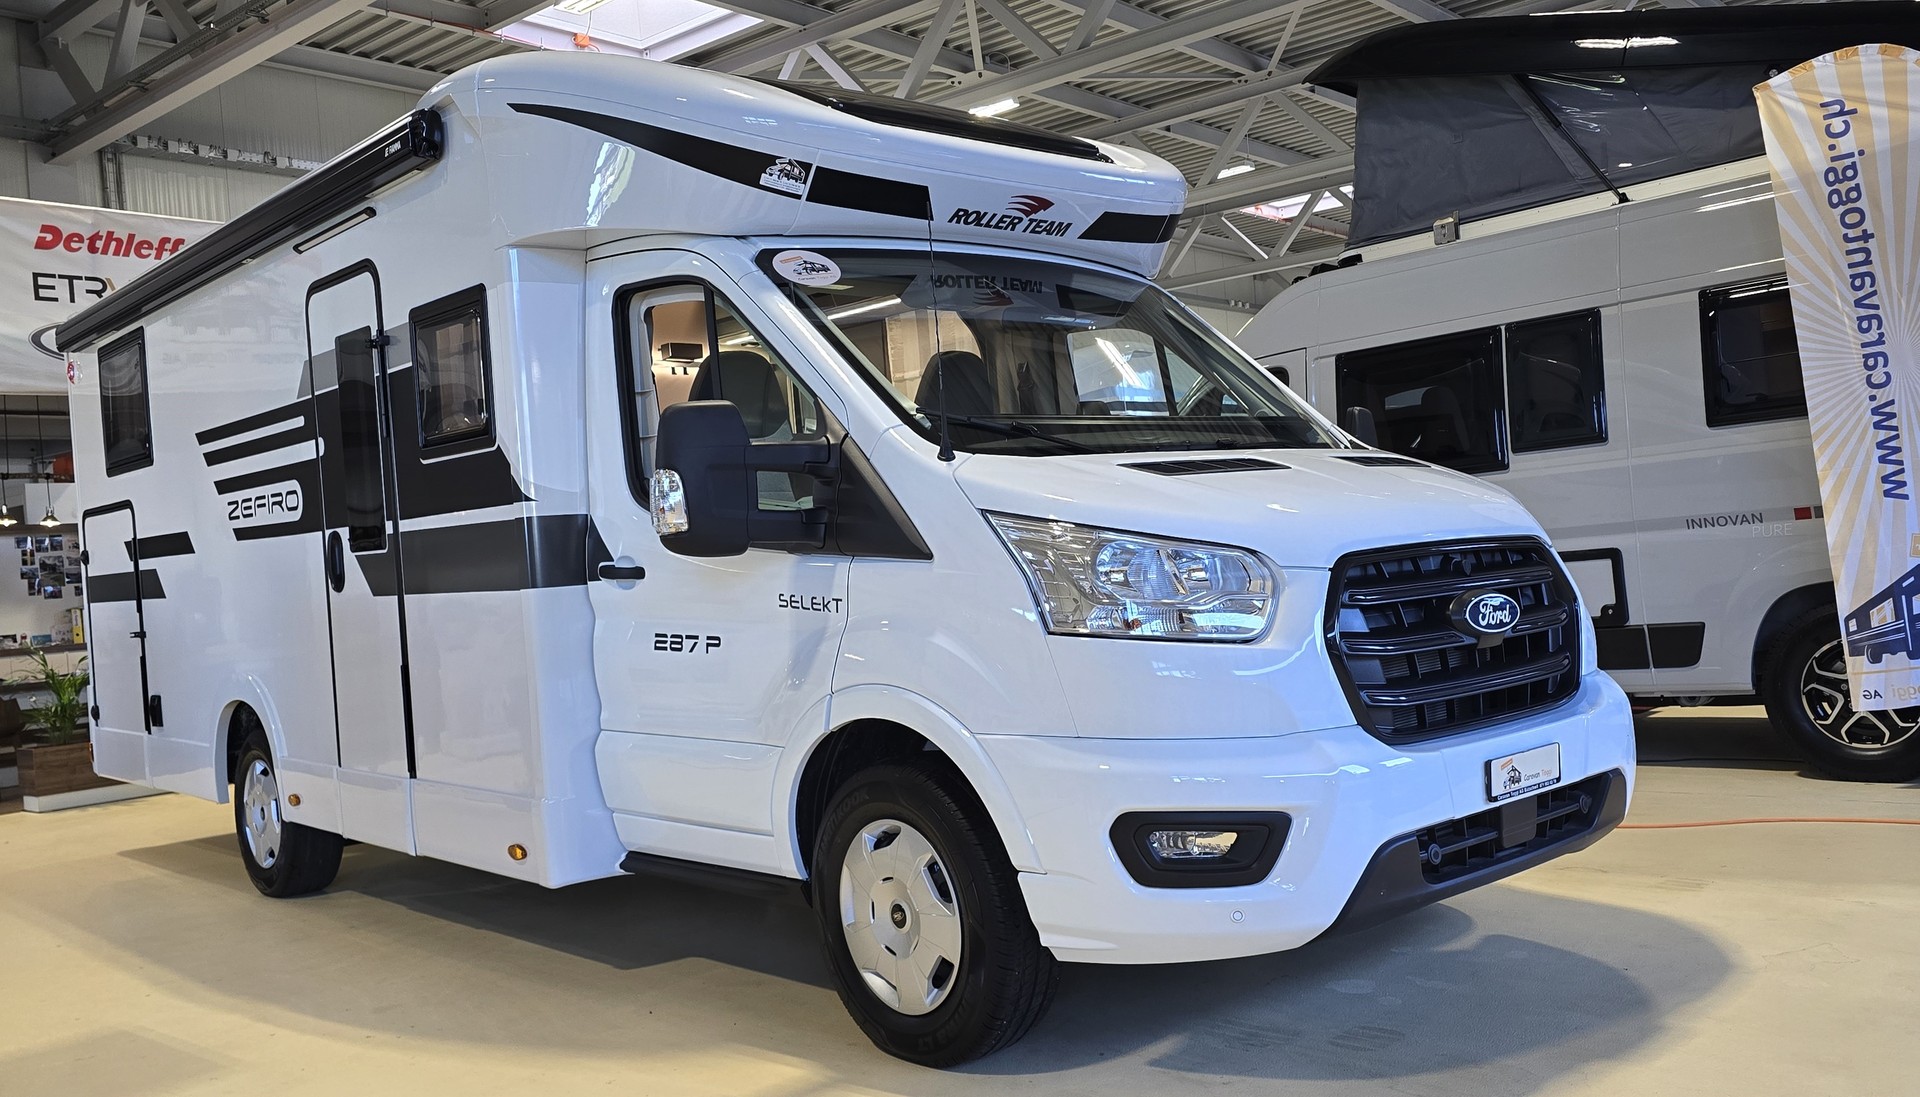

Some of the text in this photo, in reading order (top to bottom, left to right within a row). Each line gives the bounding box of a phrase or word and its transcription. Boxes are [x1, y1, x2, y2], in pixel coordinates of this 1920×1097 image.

[947, 207, 1073, 238] ROLLER TEAM
[227, 489, 300, 521] ZEFIRO
[1685, 512, 1764, 530] INNOVAN
[1752, 522, 1793, 538] PURE
[1478, 597, 1512, 627] Ford
[653, 633, 722, 654] 287 P
[1523, 772, 1541, 782] Caravan
